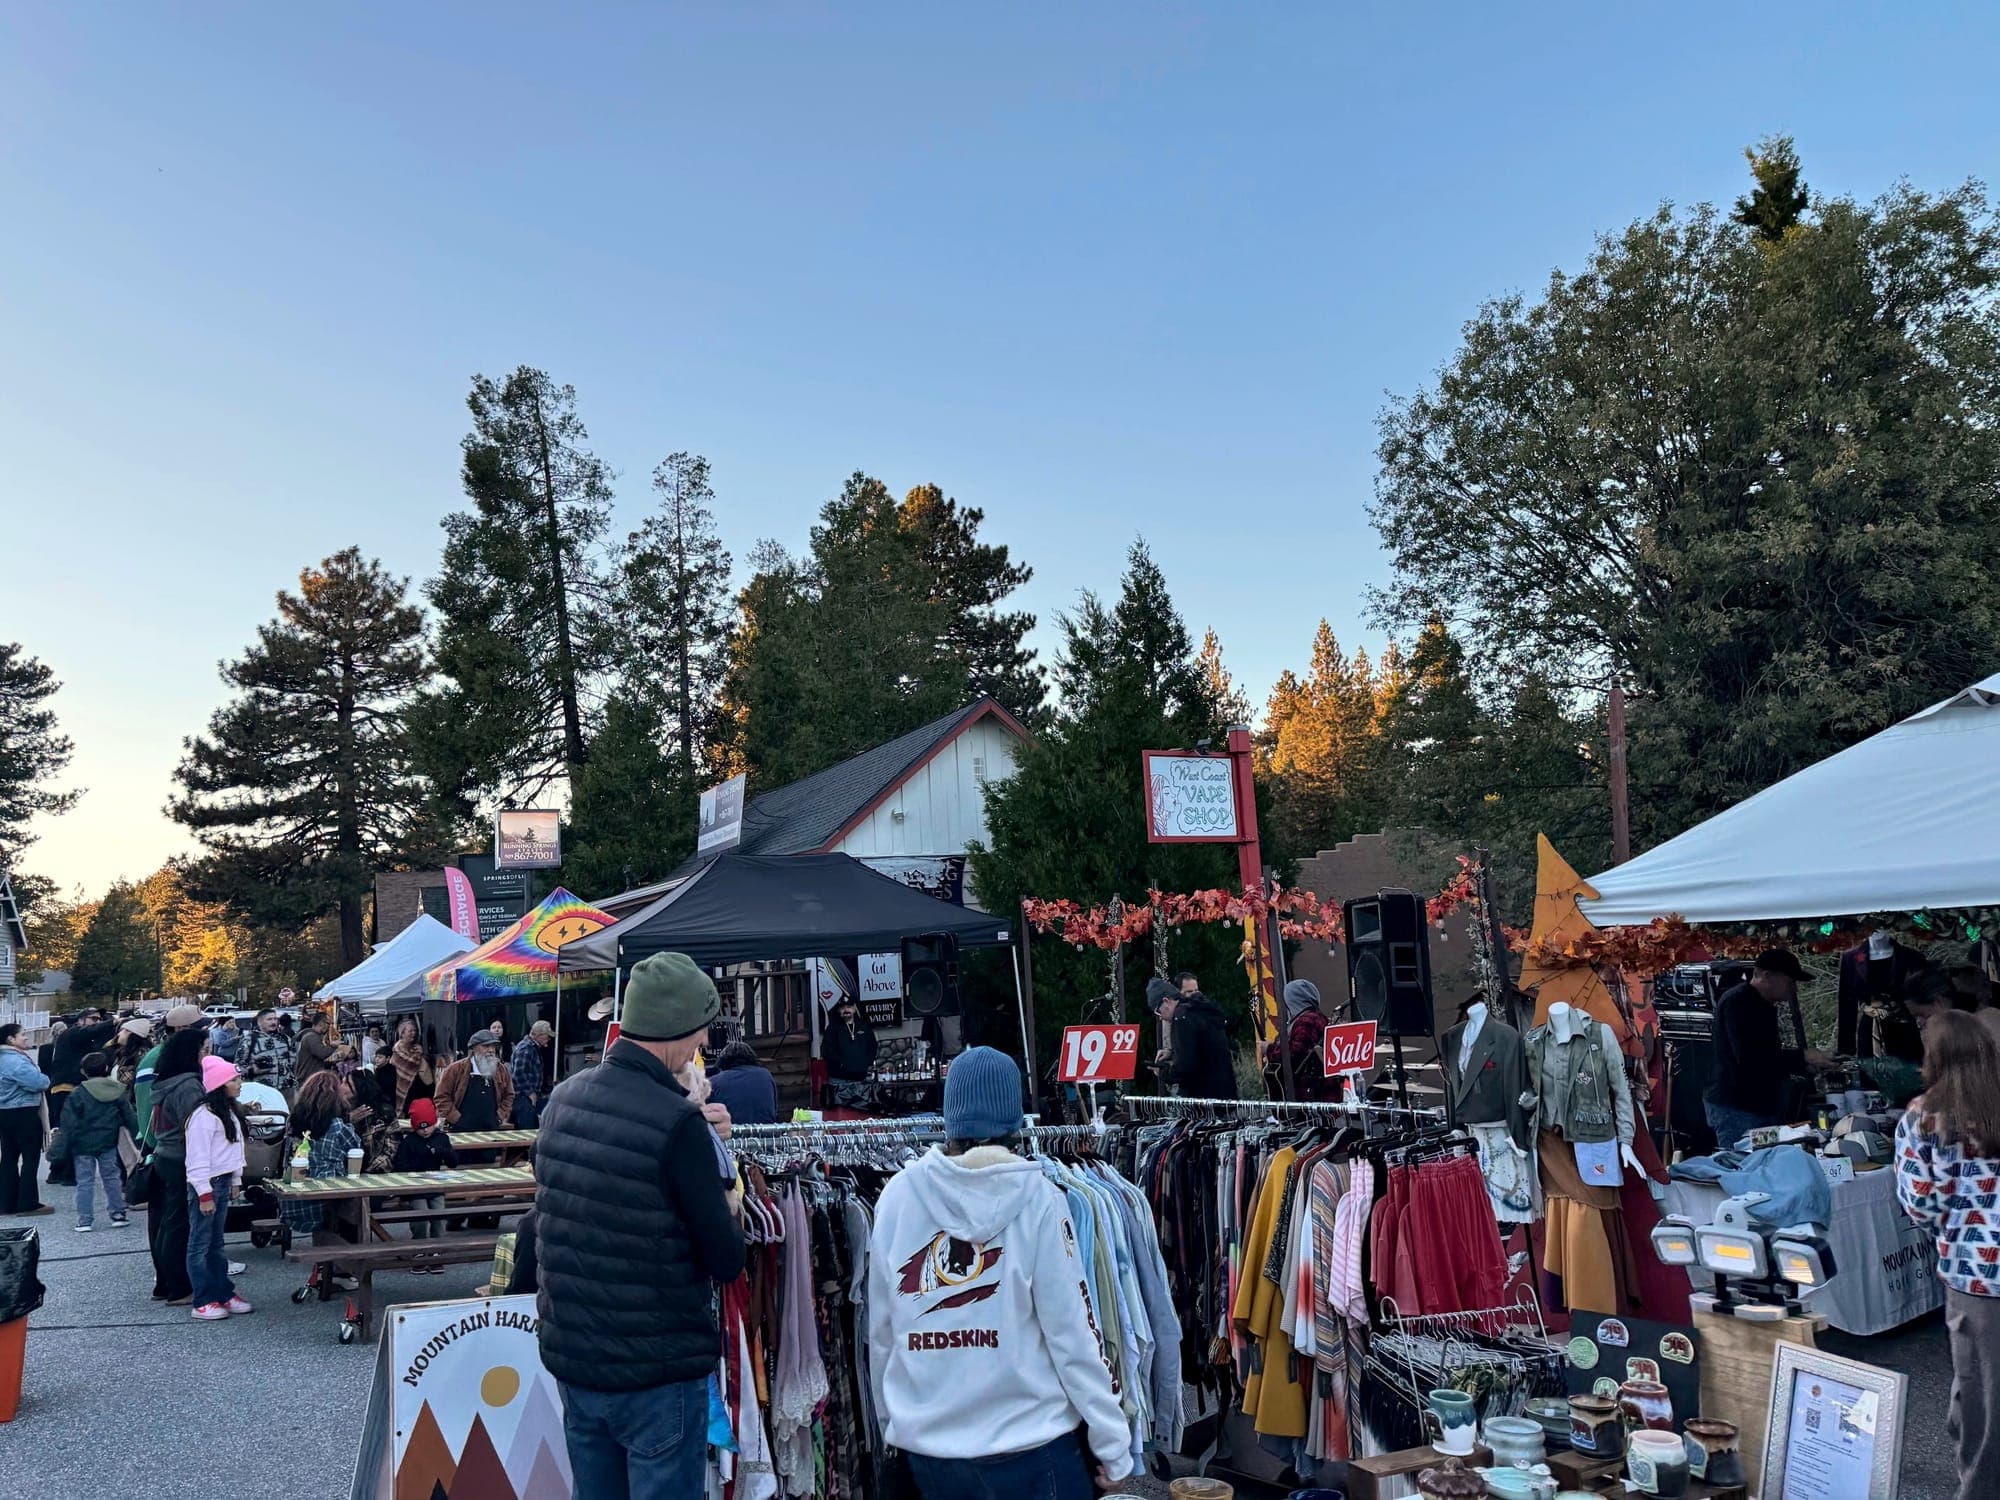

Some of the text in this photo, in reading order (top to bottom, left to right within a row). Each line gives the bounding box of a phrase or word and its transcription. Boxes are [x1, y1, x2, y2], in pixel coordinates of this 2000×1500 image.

[1174, 765, 1227, 781] West Coast
[1181, 784, 1228, 803] VAPE
[1183, 806, 1230, 825] SHOP
[514, 851, 554, 861] 867-7001
[478, 906, 505, 914] RVICES
[871, 961, 886, 975] Cut
[484, 969, 552, 989] COFFEE
[863, 978, 897, 993] Above
[1065, 1029, 1136, 1078] 19 99
[1327, 1032, 1373, 1068] Sale
[402, 1311, 490, 1388] MOUNTAIN
[907, 1328, 999, 1352] REDSKINS
